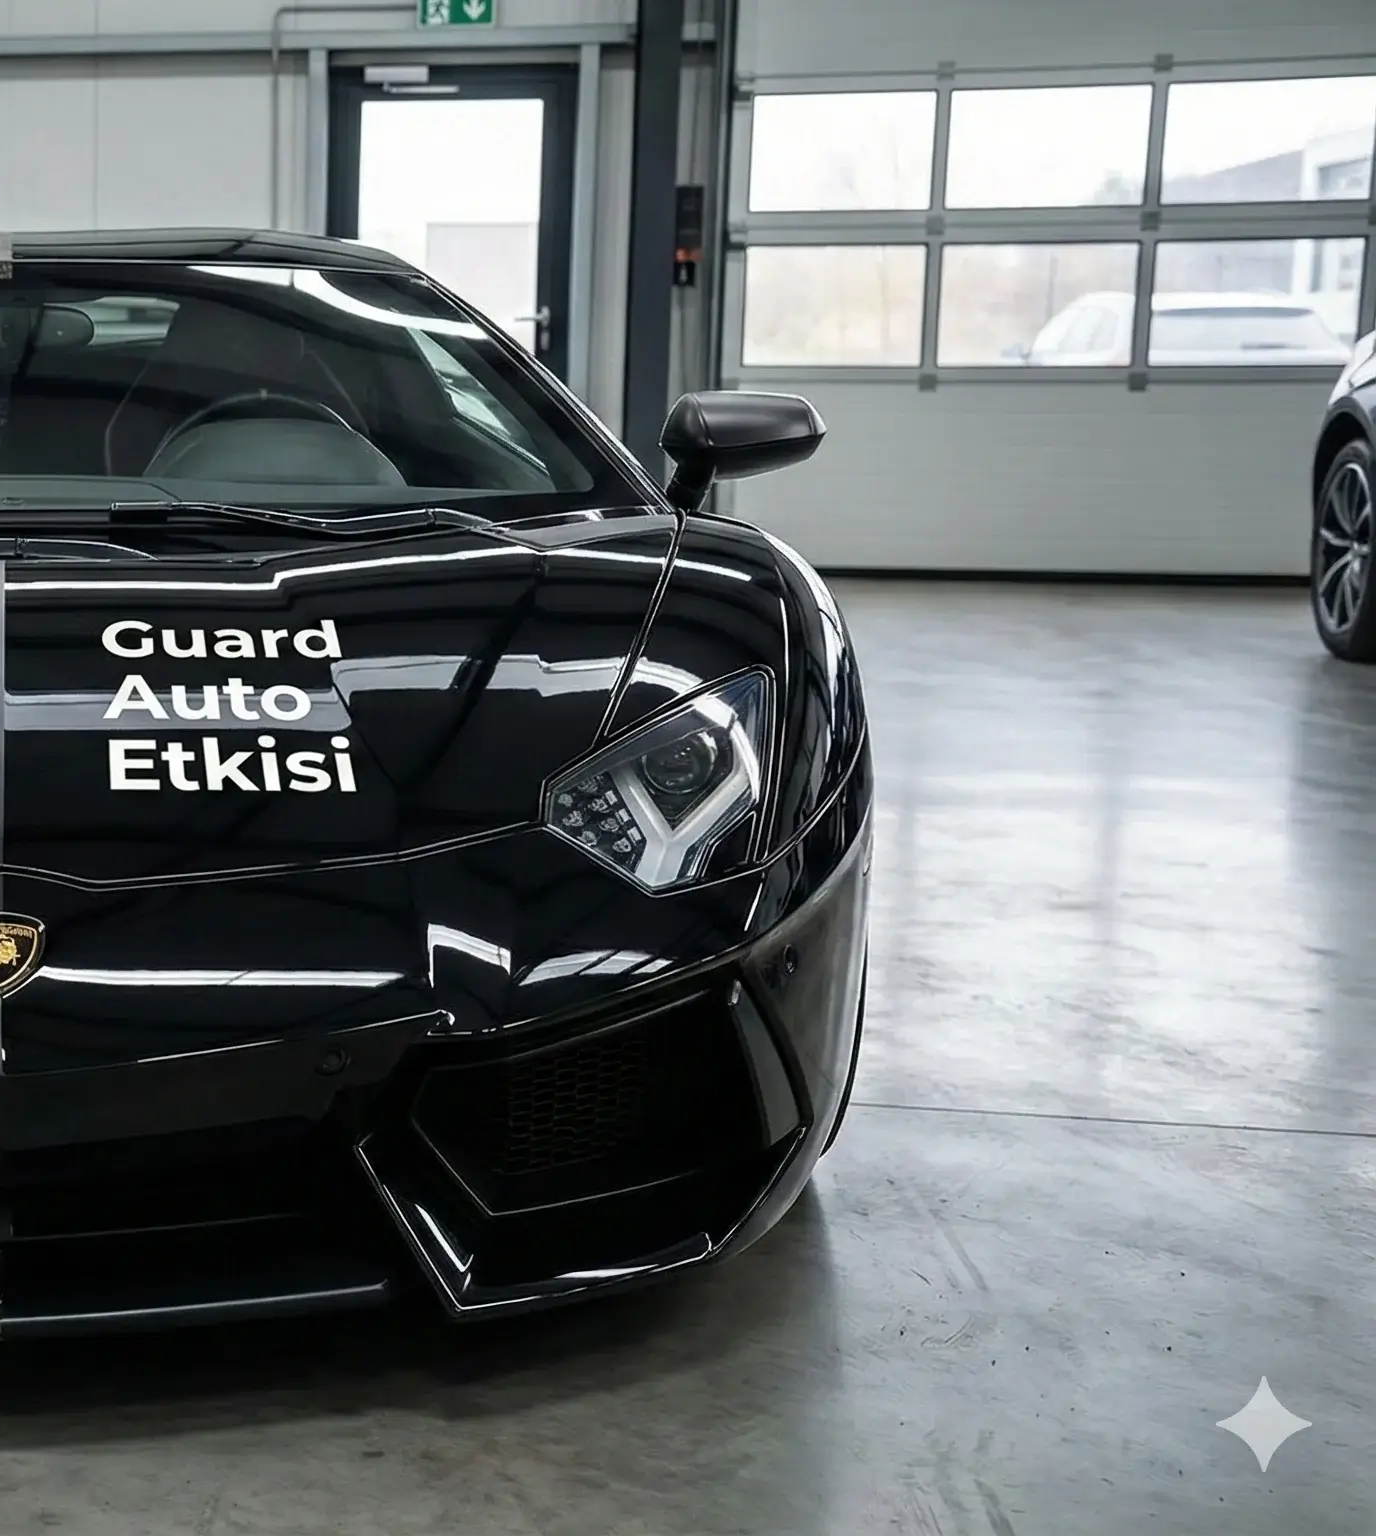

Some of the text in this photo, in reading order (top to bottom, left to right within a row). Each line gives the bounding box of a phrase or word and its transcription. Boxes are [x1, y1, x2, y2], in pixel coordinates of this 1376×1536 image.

[102, 619, 343, 659] Guard
[102, 674, 312, 721] Auto
[108, 735, 357, 792] Etkisi
